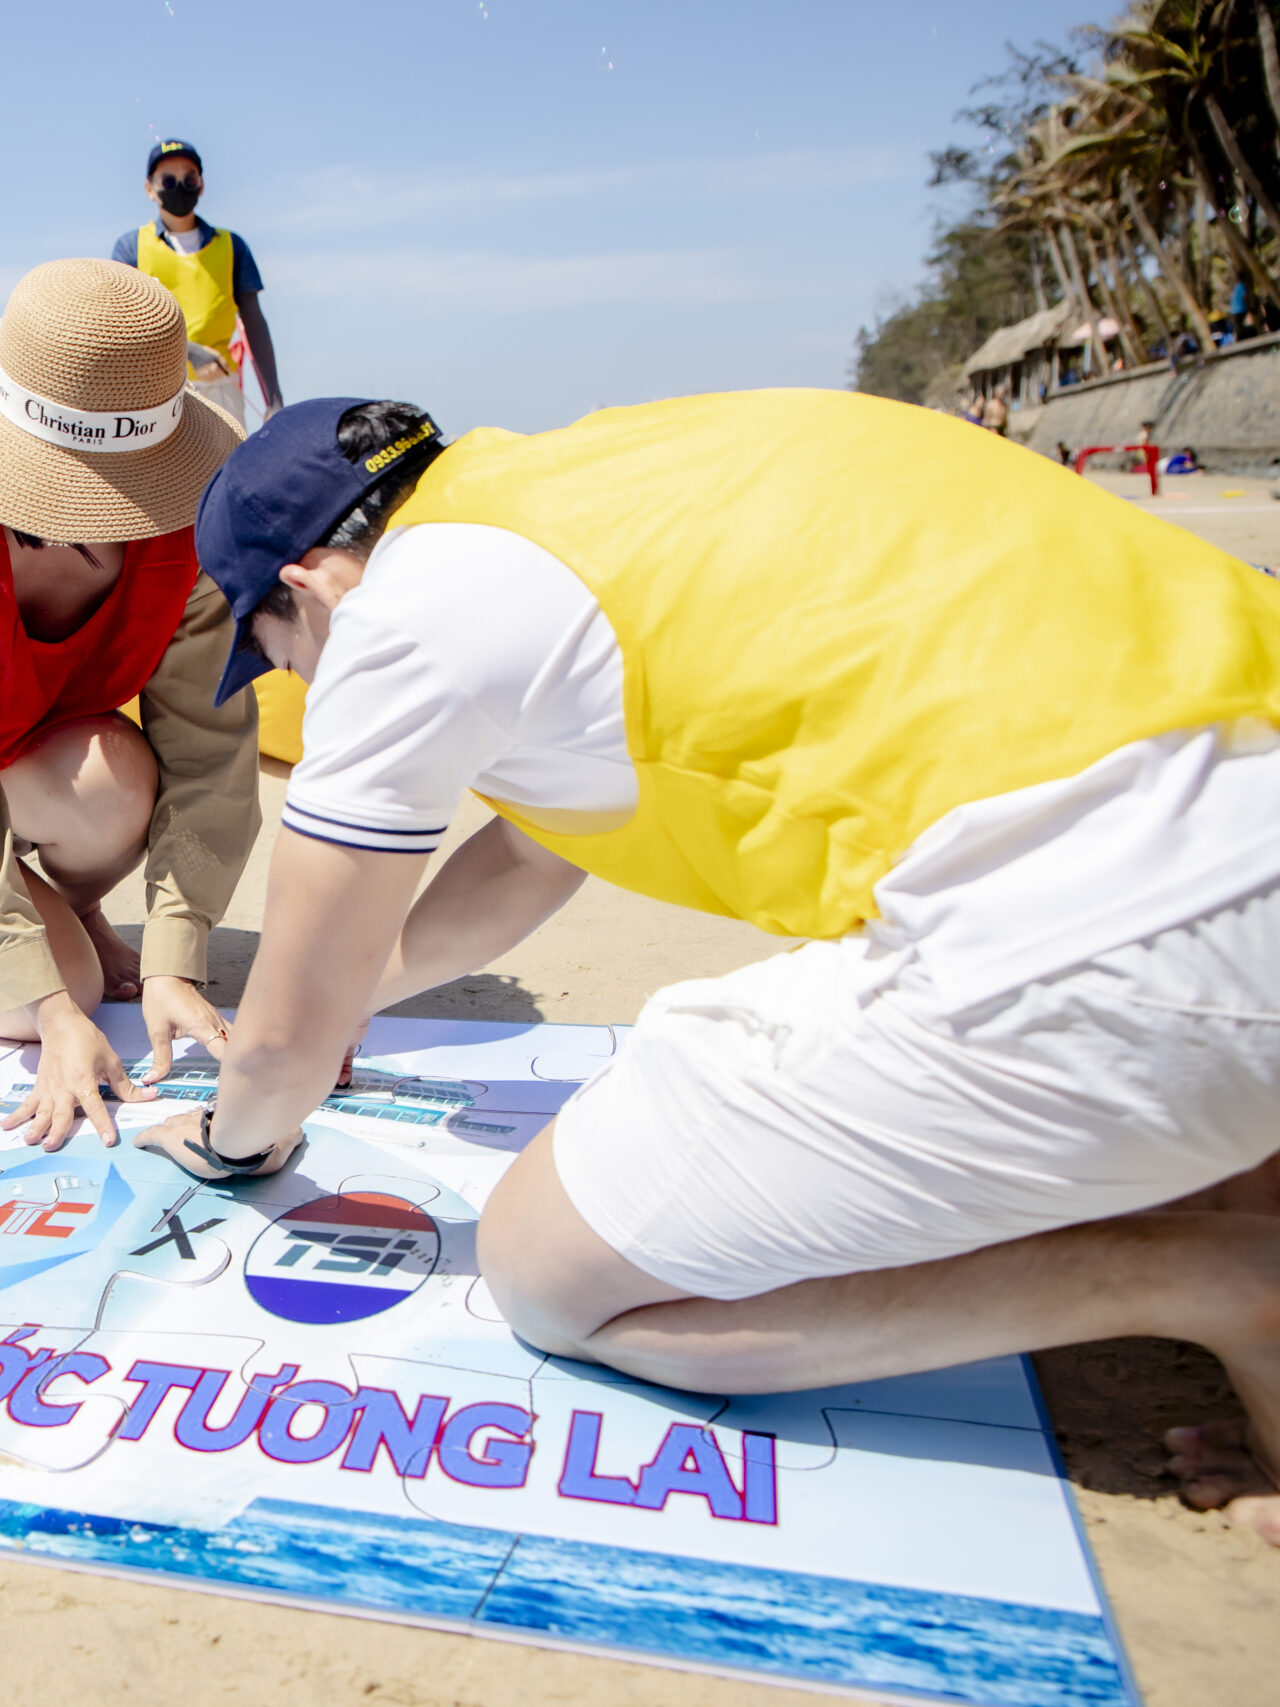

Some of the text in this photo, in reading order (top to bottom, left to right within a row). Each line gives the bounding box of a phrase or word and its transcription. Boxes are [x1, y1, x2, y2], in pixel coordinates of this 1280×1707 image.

[25, 399, 157, 439] Christian Dior
[72, 436, 104, 446] PARIS
[108, 1360, 540, 1489] TƯƠNG
[557, 1408, 780, 1527] LAI
